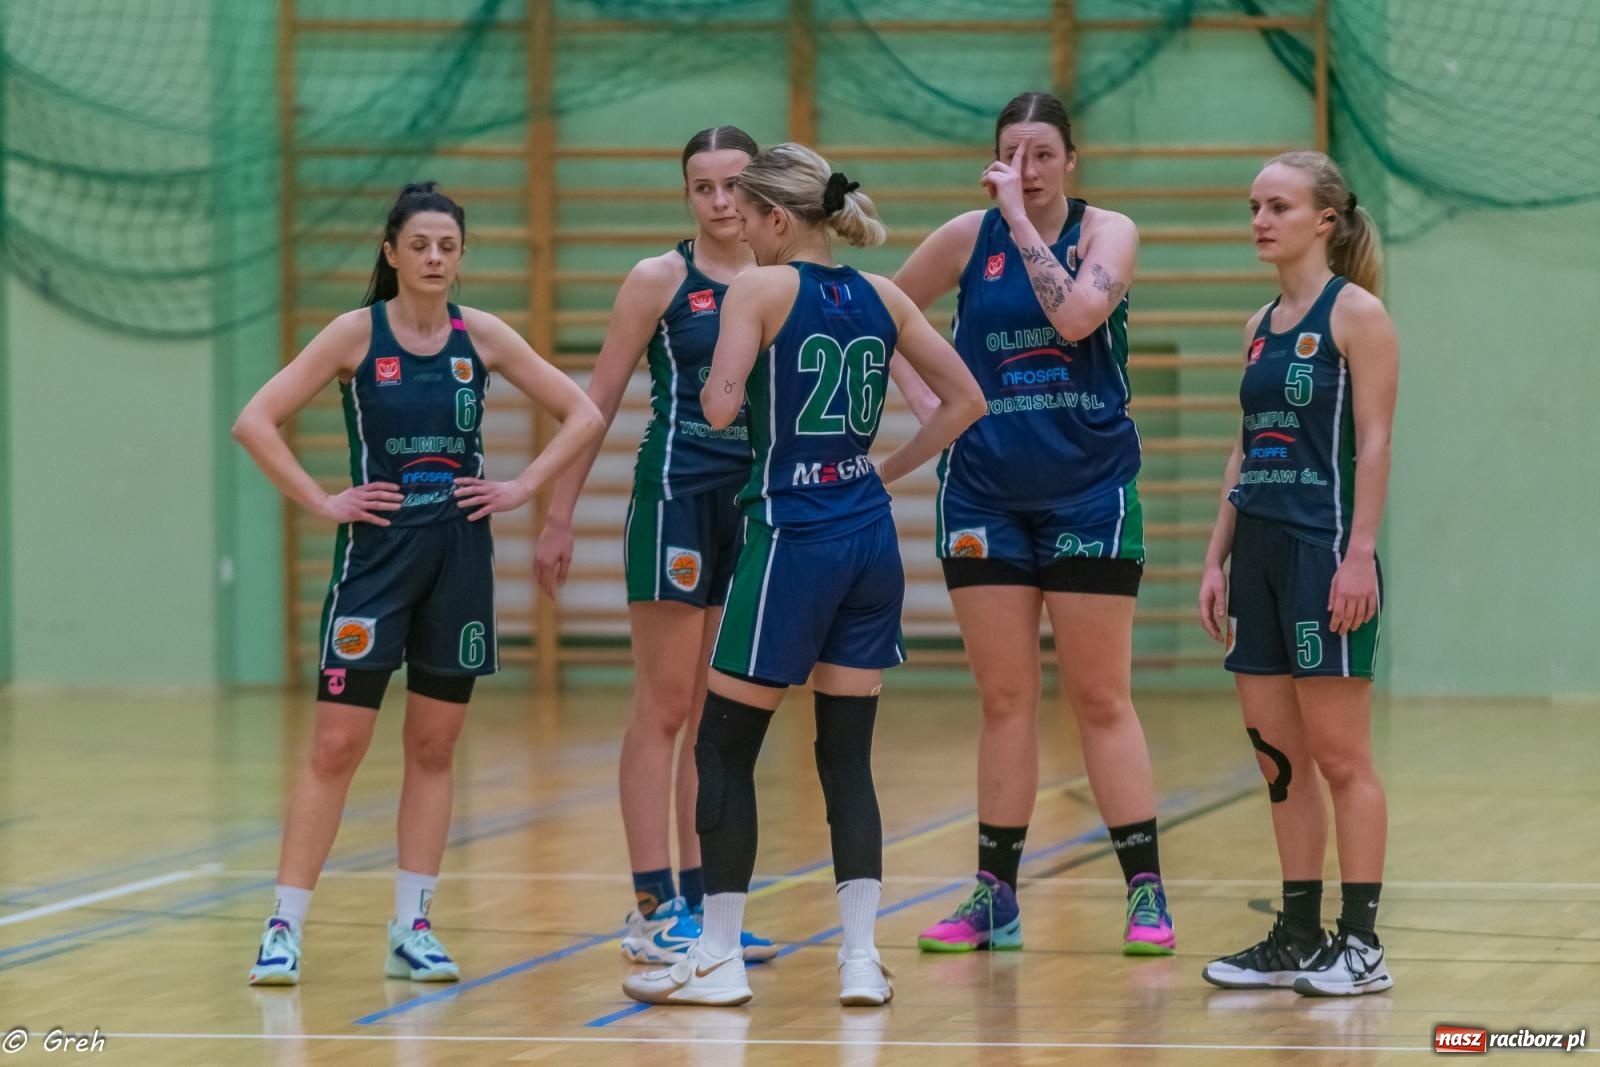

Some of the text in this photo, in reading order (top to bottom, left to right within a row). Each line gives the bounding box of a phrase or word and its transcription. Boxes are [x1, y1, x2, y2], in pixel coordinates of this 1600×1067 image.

[796, 333, 886, 436] 26
[1285, 363, 1313, 406] 5
[456, 388, 476, 431] 6
[386, 436, 466, 455] OLIMPIA
[459, 621, 486, 668] 6
[1296, 621, 1323, 669] 5
